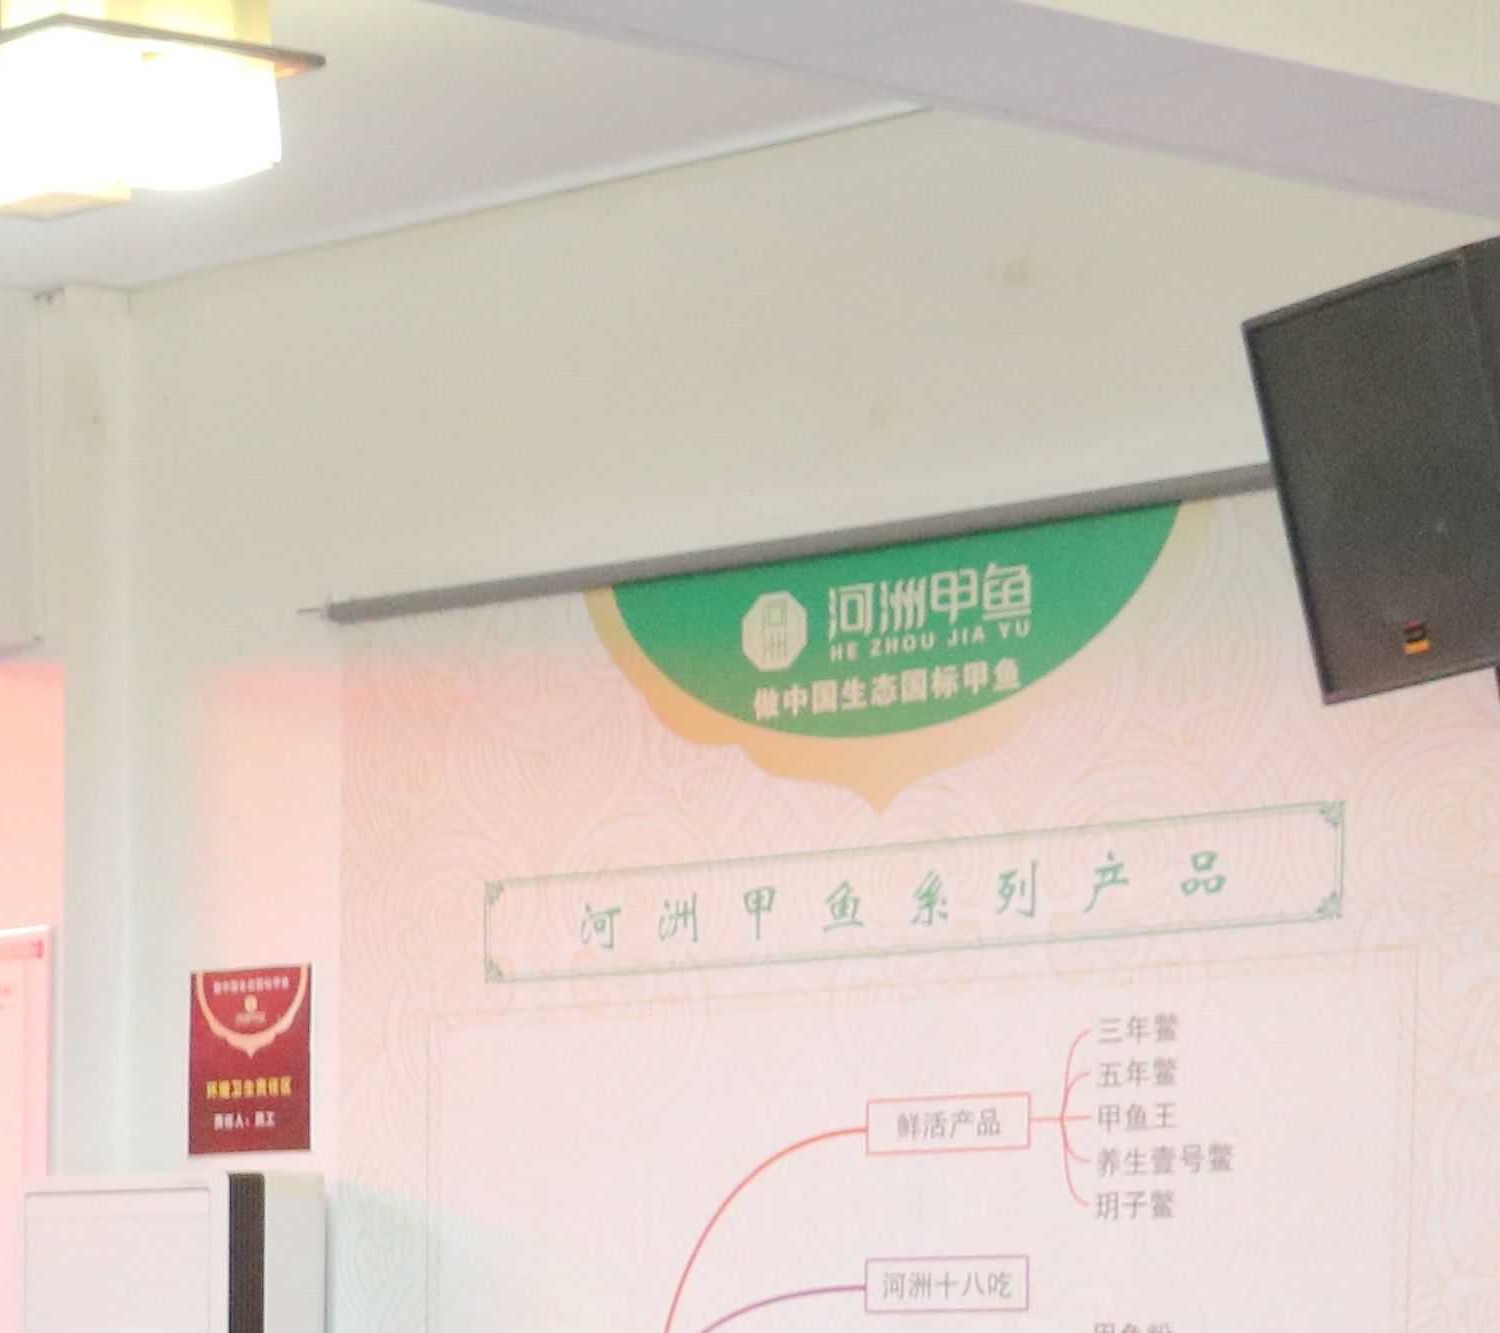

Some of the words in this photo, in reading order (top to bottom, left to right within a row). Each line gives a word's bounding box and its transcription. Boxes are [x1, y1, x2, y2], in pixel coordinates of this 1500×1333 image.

[828, 562, 1032, 641] 河洲甲鱼
[830, 641, 858, 662] HE
[870, 632, 936, 657] ZHOU
[948, 625, 986, 647] JIA
[998, 619, 1031, 639] YU
[753, 658, 1020, 720] 做中国生态国标甲鱼
[579, 849, 1227, 950] 河洲甲鱼系列产品
[1098, 1013, 1178, 1044] 三年鳖
[1097, 1057, 1178, 1088] 五年鳖
[896, 1107, 1001, 1140] 鲜活产品
[1098, 1102, 1178, 1133] 甲鱼王
[1098, 1142, 1234, 1177] 养生壹号鳖
[882, 1270, 1013, 1301] 河洲十八吃
